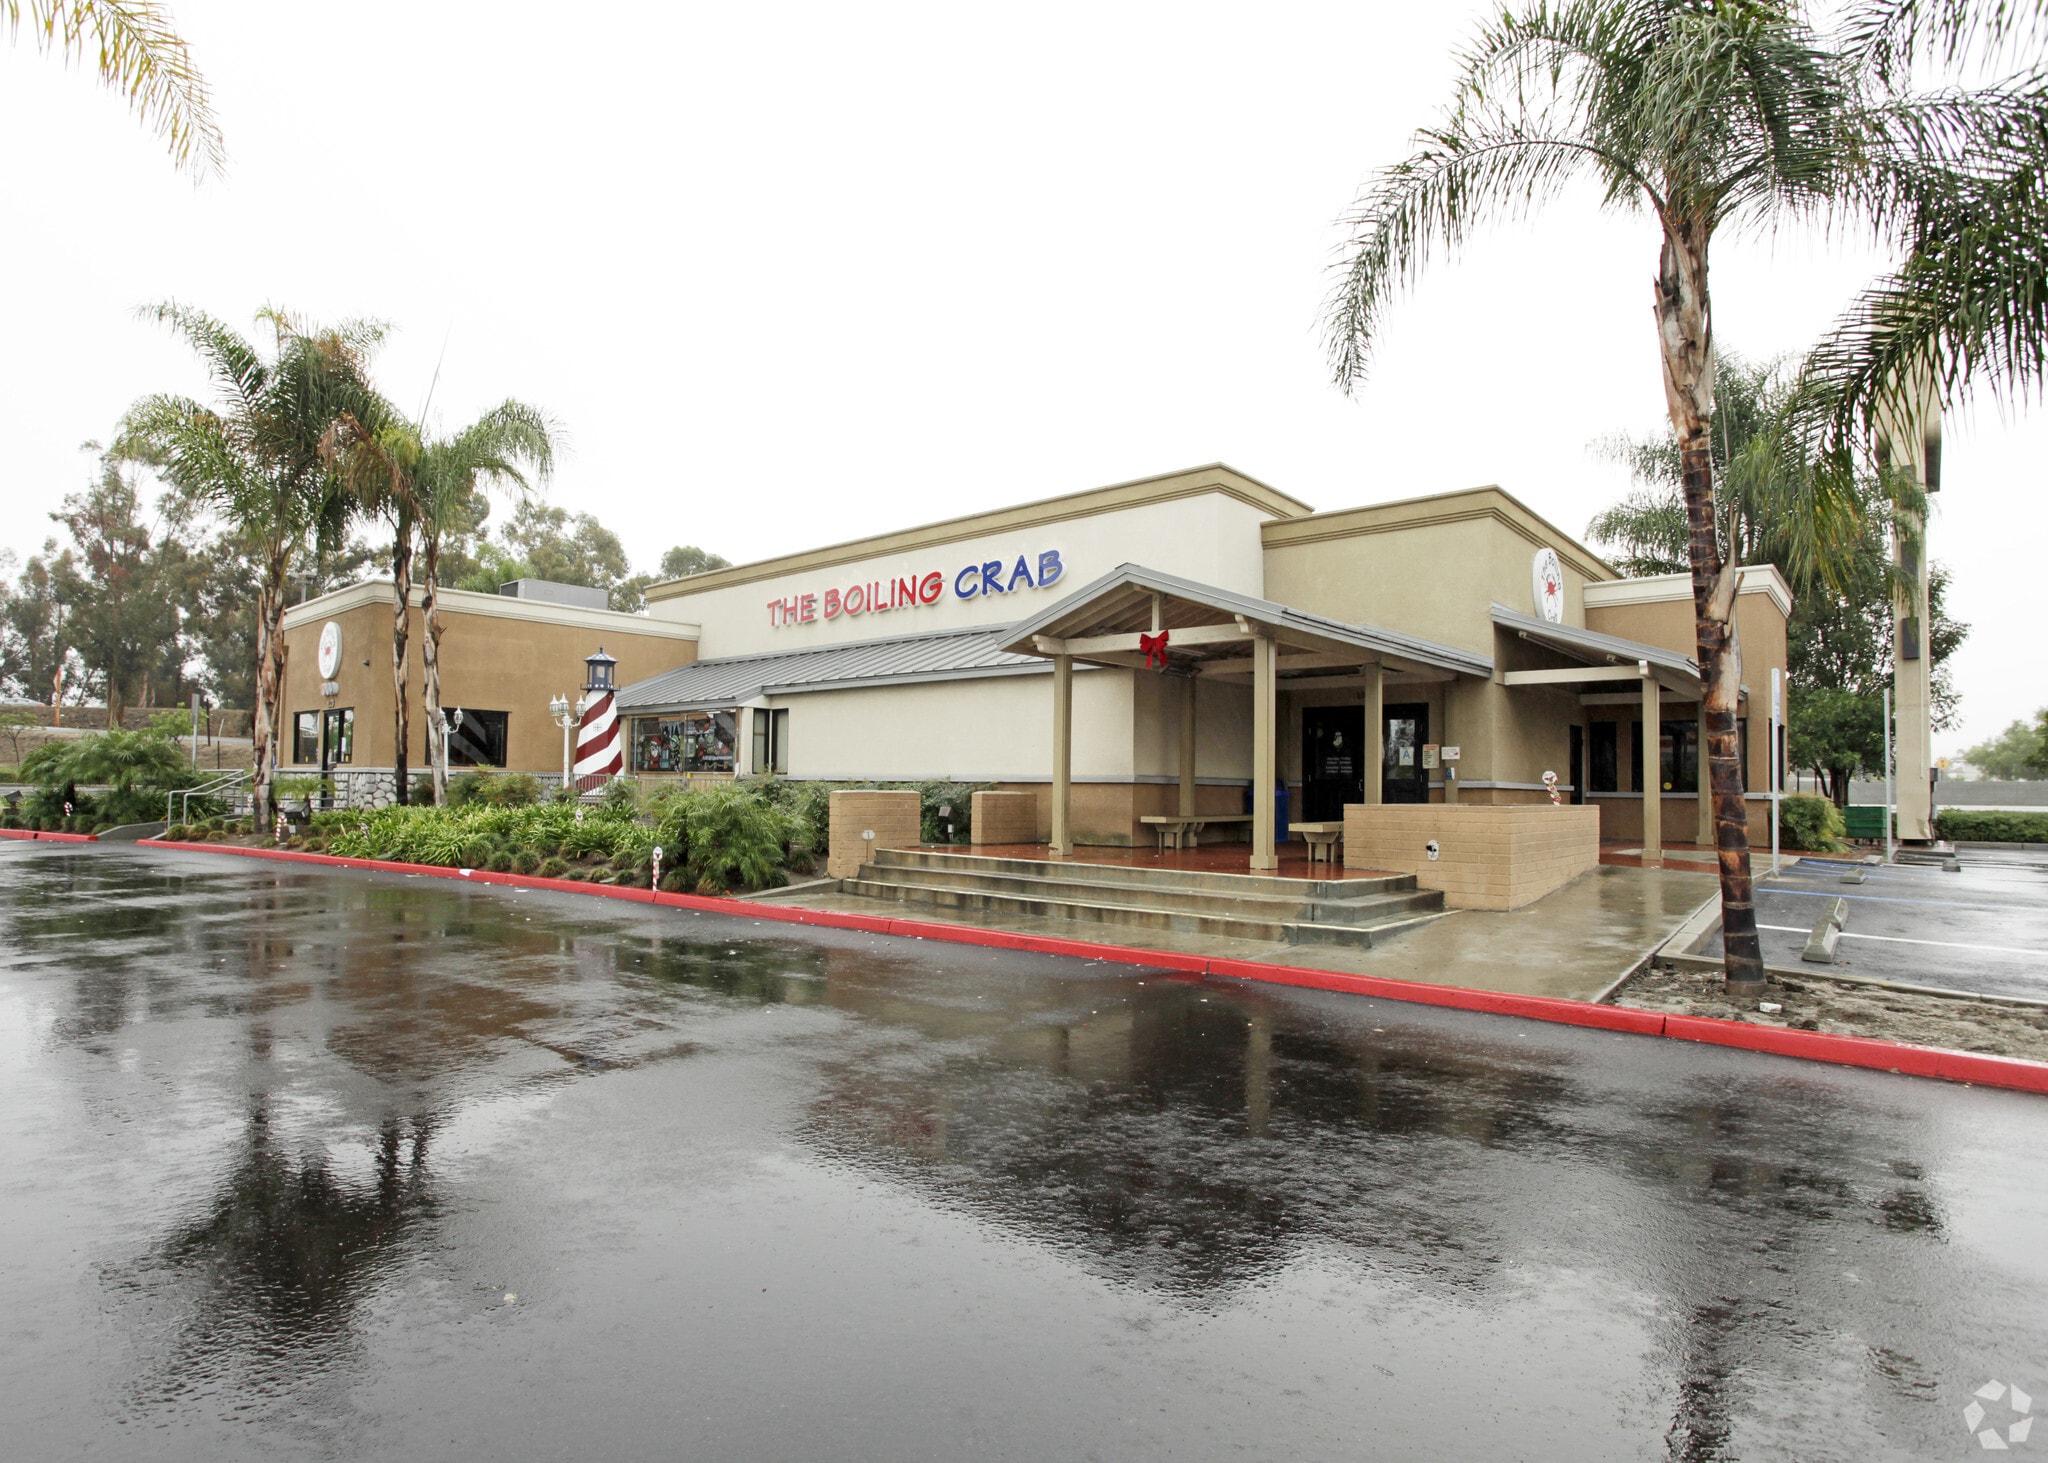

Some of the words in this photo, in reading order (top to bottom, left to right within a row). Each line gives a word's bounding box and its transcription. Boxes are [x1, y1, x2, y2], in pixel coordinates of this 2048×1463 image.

[767, 593, 815, 627] THE
[823, 571, 944, 620] BOILING
[954, 549, 1065, 599] CRAB
[1402, 749, 1411, 760] A
